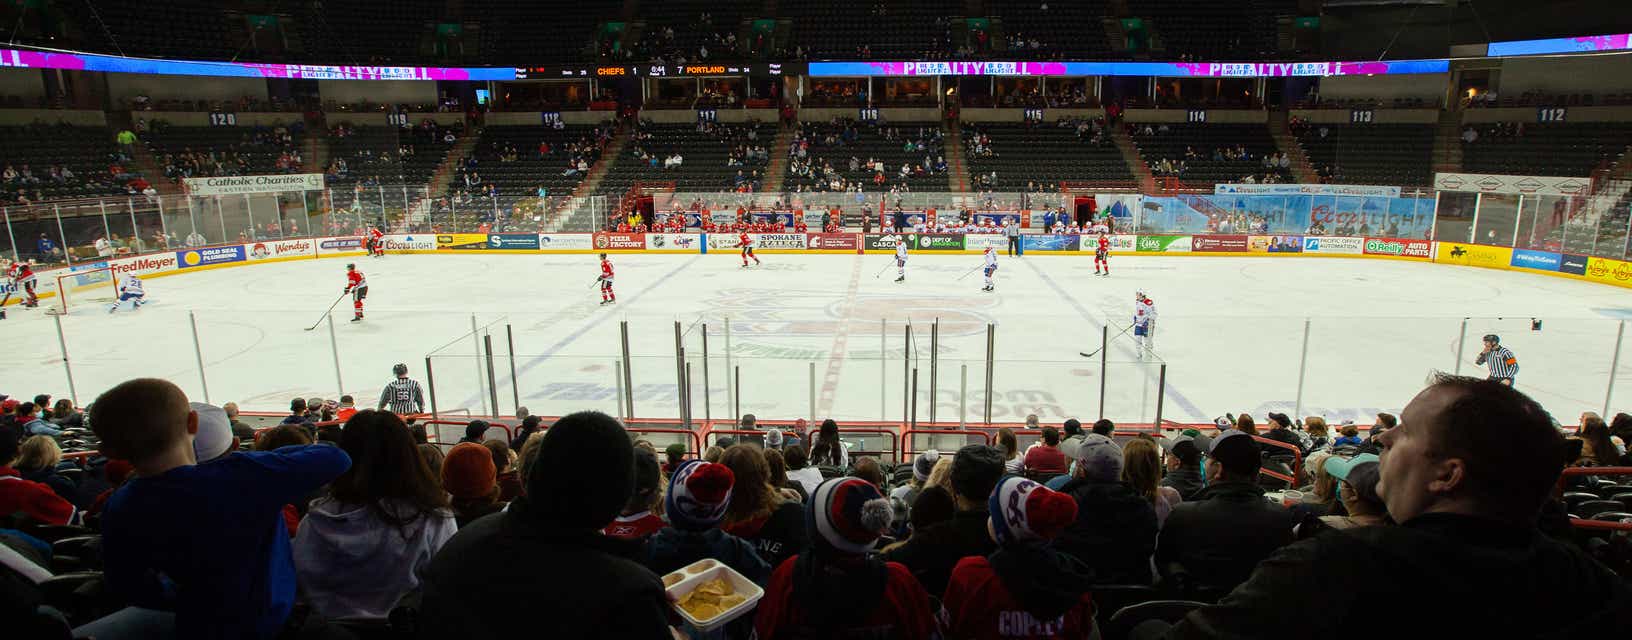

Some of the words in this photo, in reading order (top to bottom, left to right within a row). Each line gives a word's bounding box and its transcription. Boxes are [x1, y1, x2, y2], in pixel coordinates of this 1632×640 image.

[632, 67, 637, 75] 1
[677, 66, 683, 74] 7
[210, 113, 236, 126] 120
[699, 110, 716, 120] 117
[1026, 110, 1042, 120] 115
[1188, 111, 1205, 122] 114
[1353, 111, 1371, 122] 113
[1540, 108, 1566, 121] 112
[207, 177, 254, 187] Catholic
[256, 175, 304, 185] Charities
[275, 241, 310, 254] Wendy's
[1408, 242, 1428, 250] AUTO
[1405, 248, 1429, 256] PARTS
[397, 391, 409, 401] 56
